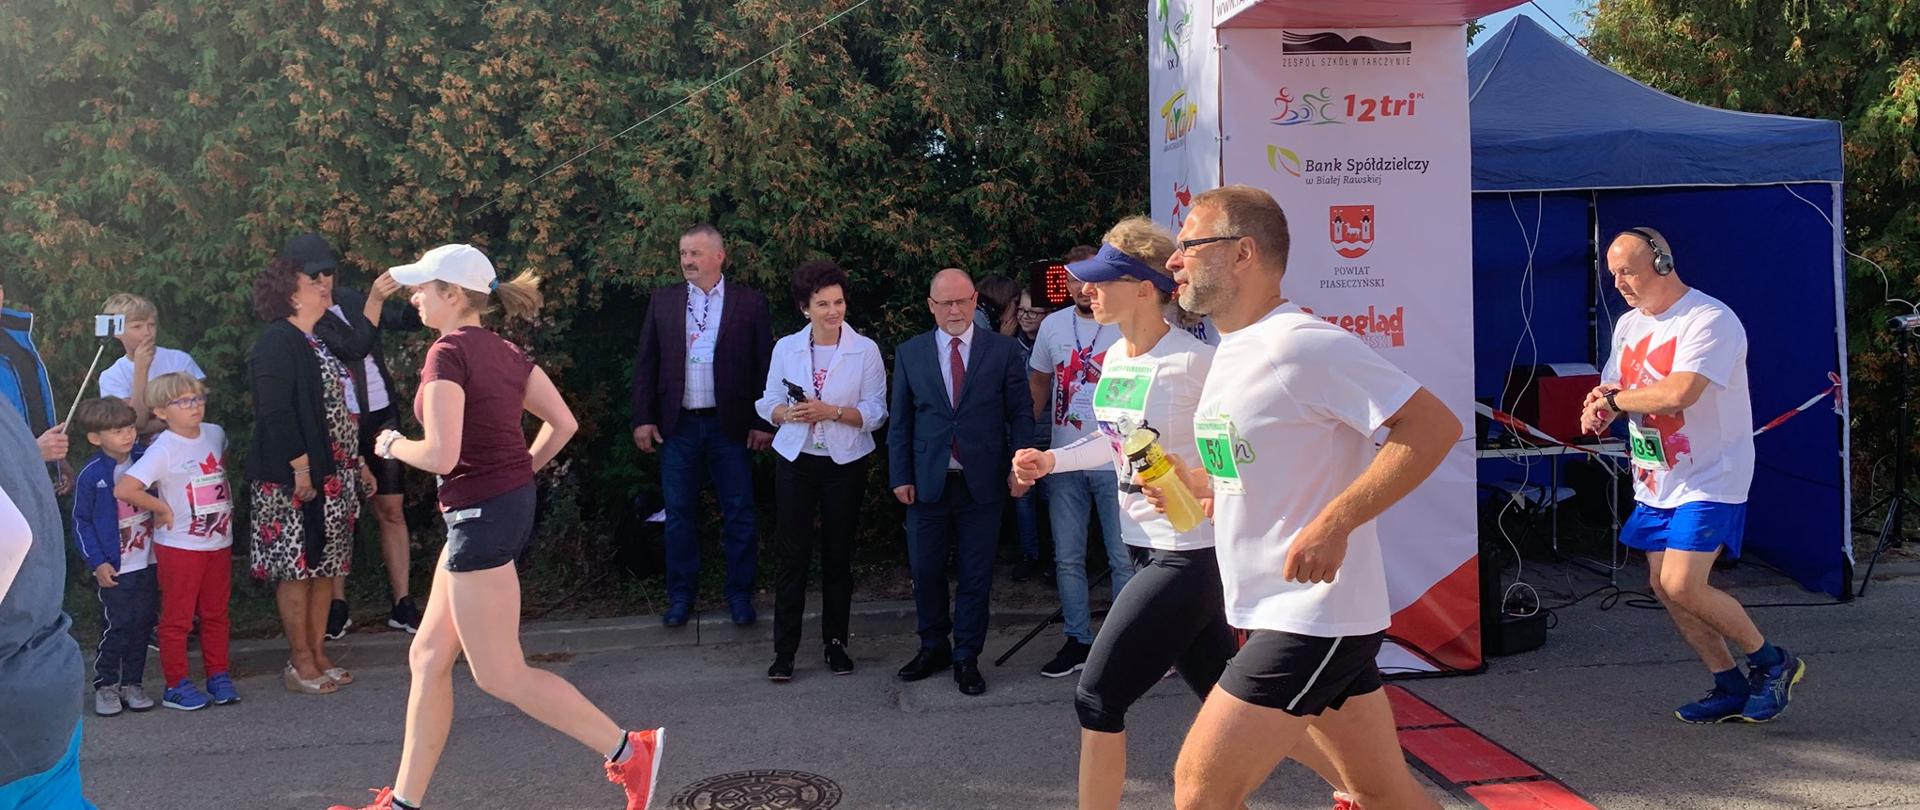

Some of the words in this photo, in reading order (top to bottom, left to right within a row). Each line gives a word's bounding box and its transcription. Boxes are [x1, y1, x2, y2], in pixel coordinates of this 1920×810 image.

[1321, 56, 1350, 67] SZKÓŁ
[1352, 57, 1359, 66] W
[1362, 56, 1411, 66] TARCZYNIE
[1343, 92, 1416, 122] 12tri
[1305, 158, 1342, 172] Bank
[1346, 157, 1430, 174] Spółdzielczy
[1305, 177, 1314, 185] w
[1316, 175, 1341, 186] Białej
[1343, 175, 1382, 186] Rawskiej
[1334, 266, 1371, 276] POWIAT
[1320, 278, 1385, 289] PIASECZYŃSKI
[1105, 378, 1137, 404] 52
[1206, 439, 1224, 470] 53
